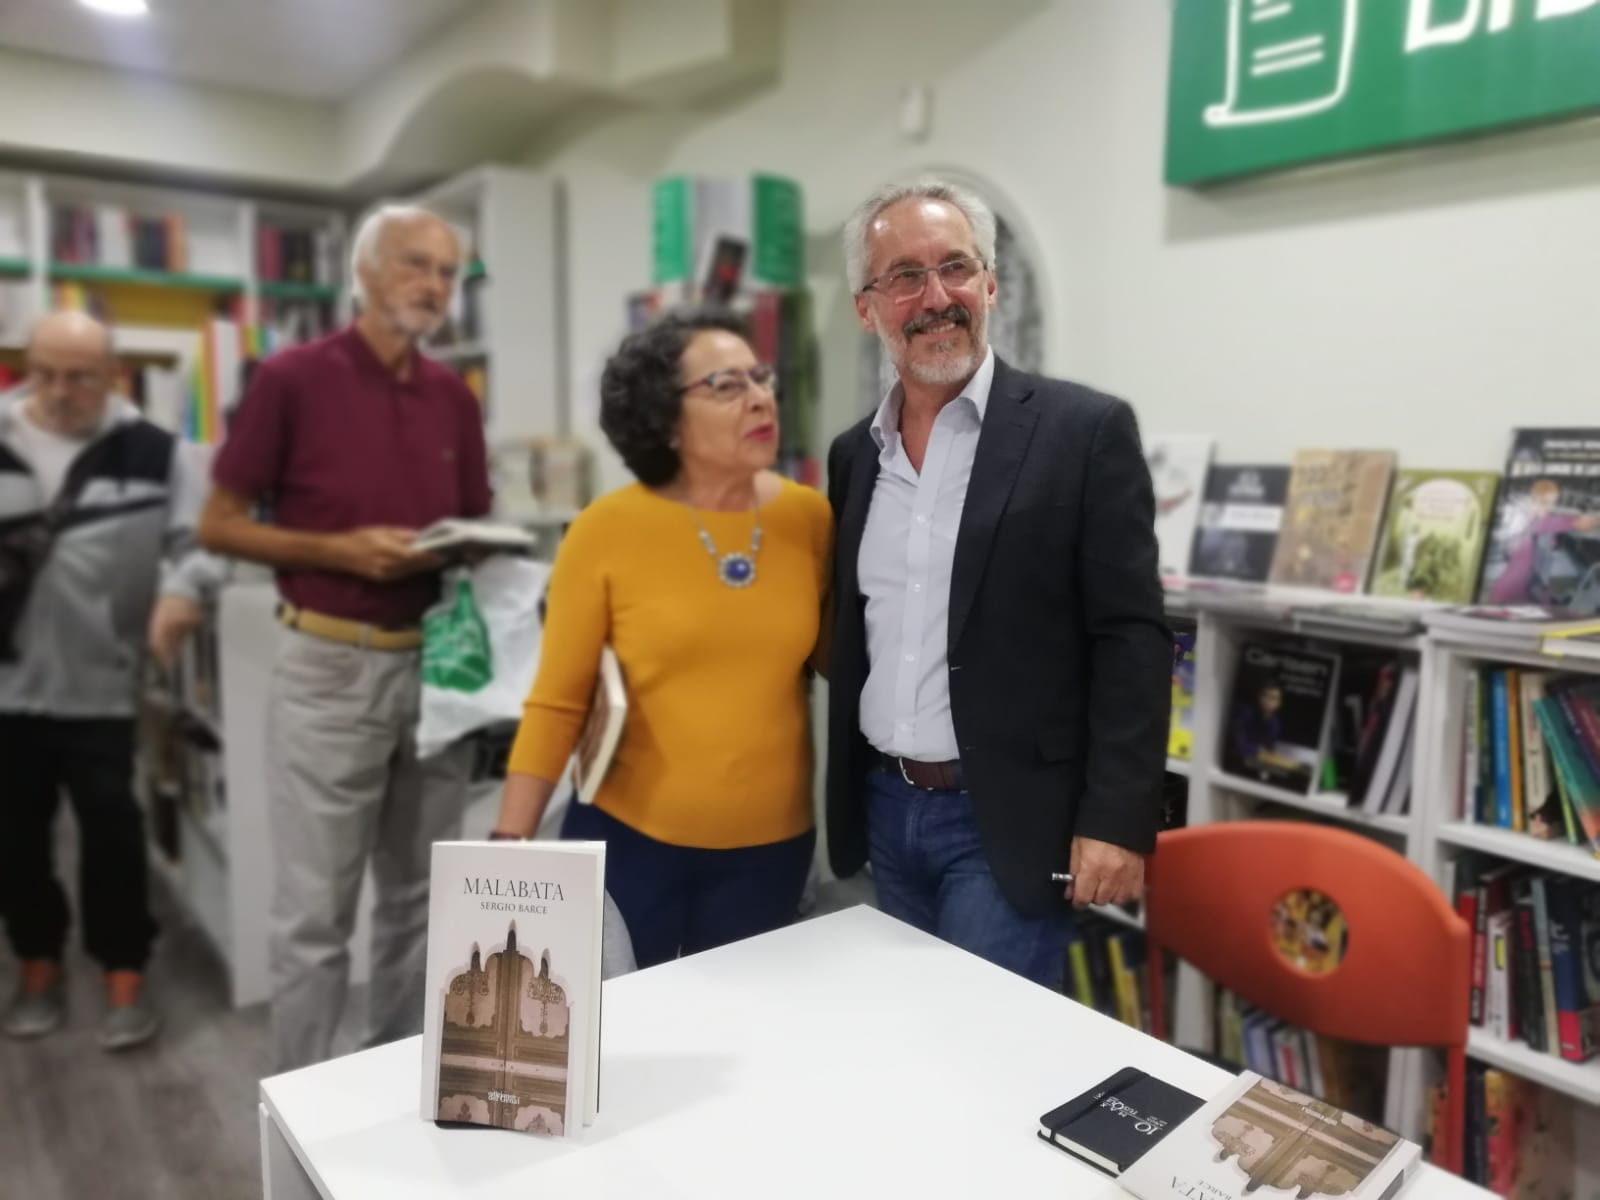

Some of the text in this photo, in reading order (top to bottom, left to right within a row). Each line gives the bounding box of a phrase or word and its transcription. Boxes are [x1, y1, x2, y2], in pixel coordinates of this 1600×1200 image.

[463, 877, 564, 901] MALABATA
[480, 901, 547, 914] SERGIO BARCE
[1134, 1121, 1158, 1135] 10
